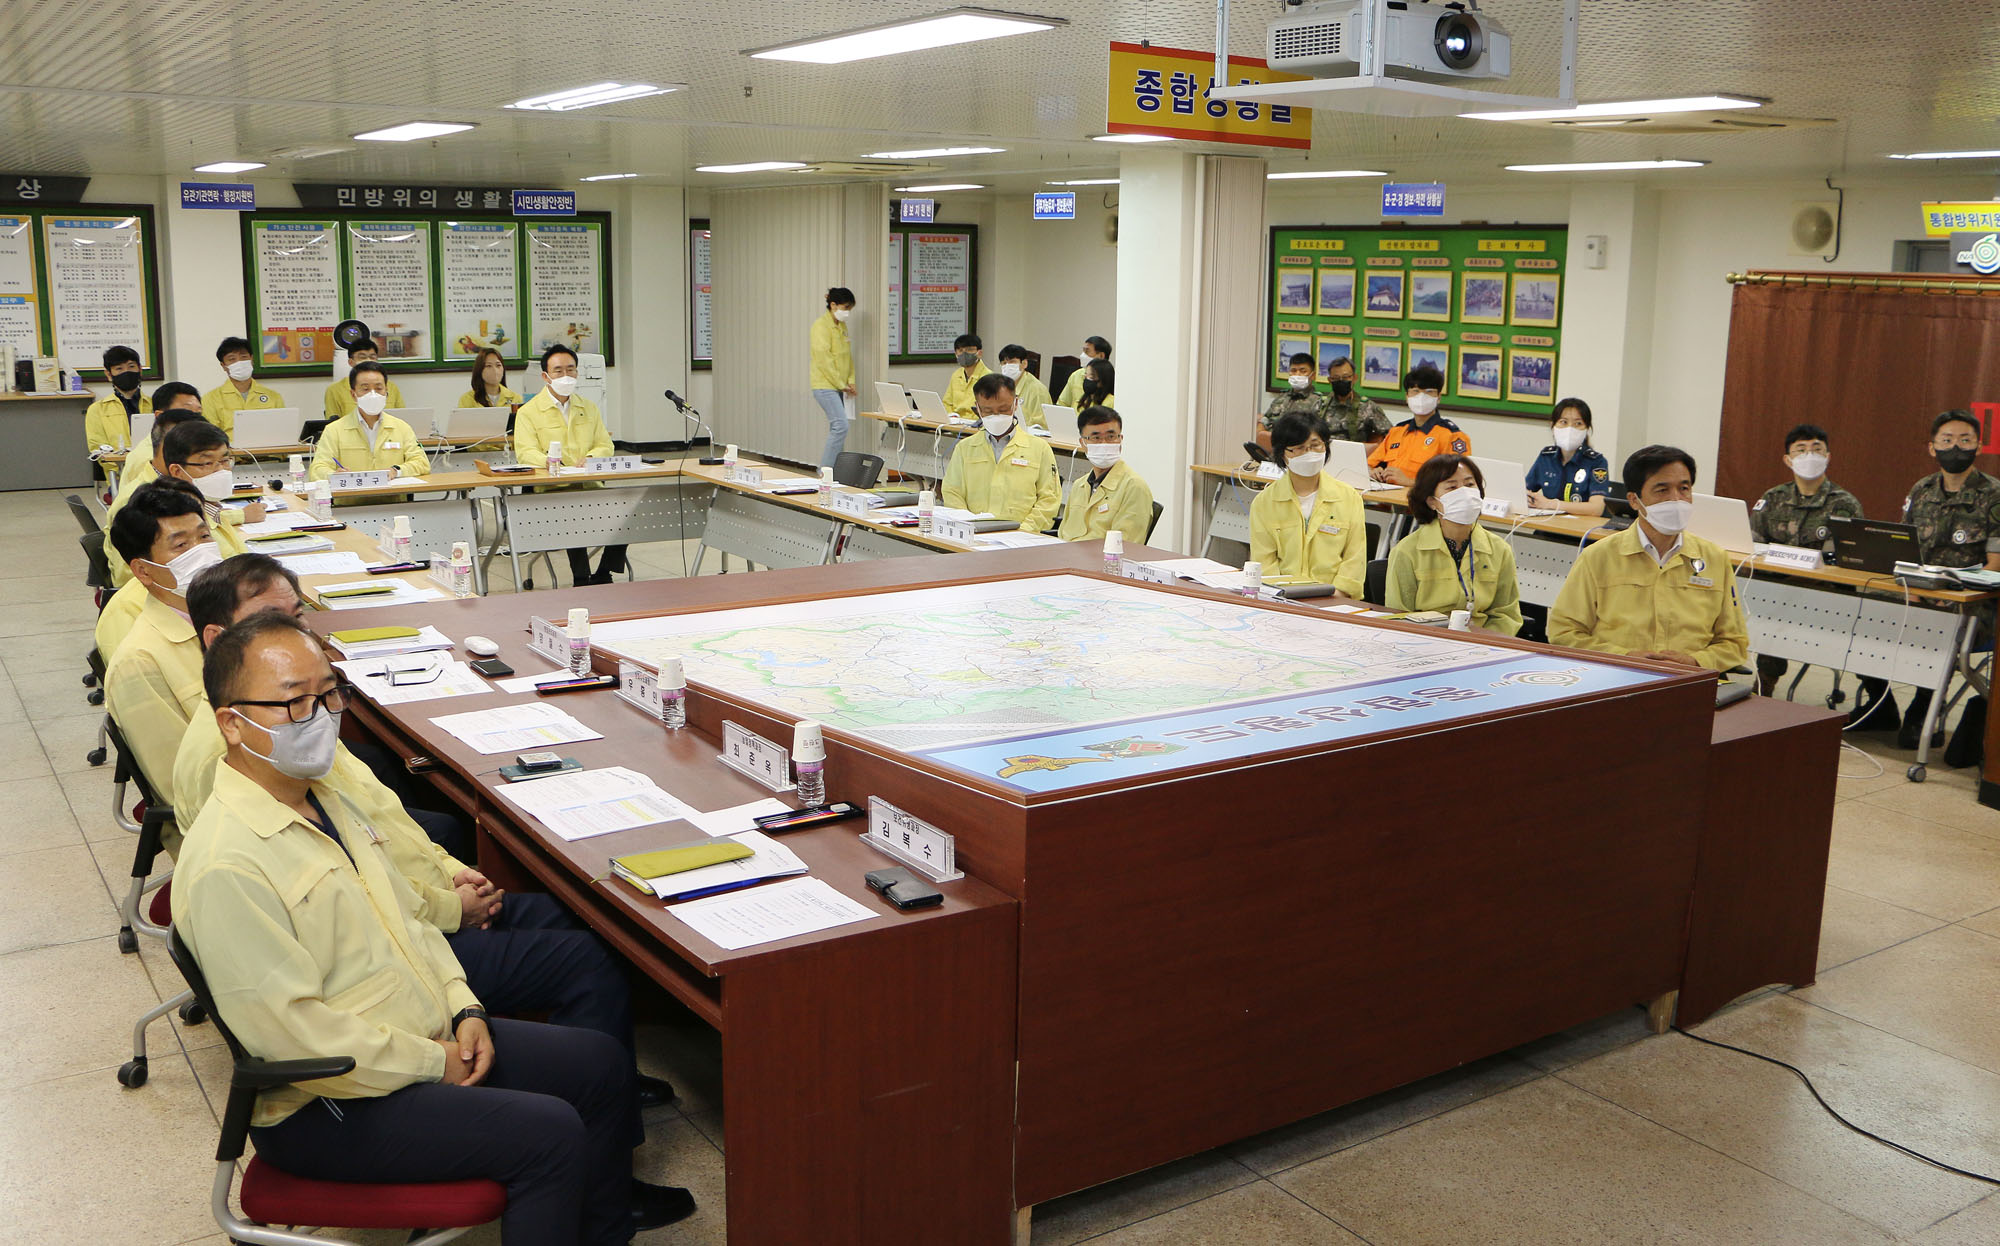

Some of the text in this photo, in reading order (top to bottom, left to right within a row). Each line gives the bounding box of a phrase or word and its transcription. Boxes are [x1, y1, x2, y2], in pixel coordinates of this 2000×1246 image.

[16, 179, 42, 198] 상
[337, 188, 437, 208] 민방위의
[517, 195, 573, 210] 시민생활안정반
[1162, 686, 1496, 744] 종합상황도
